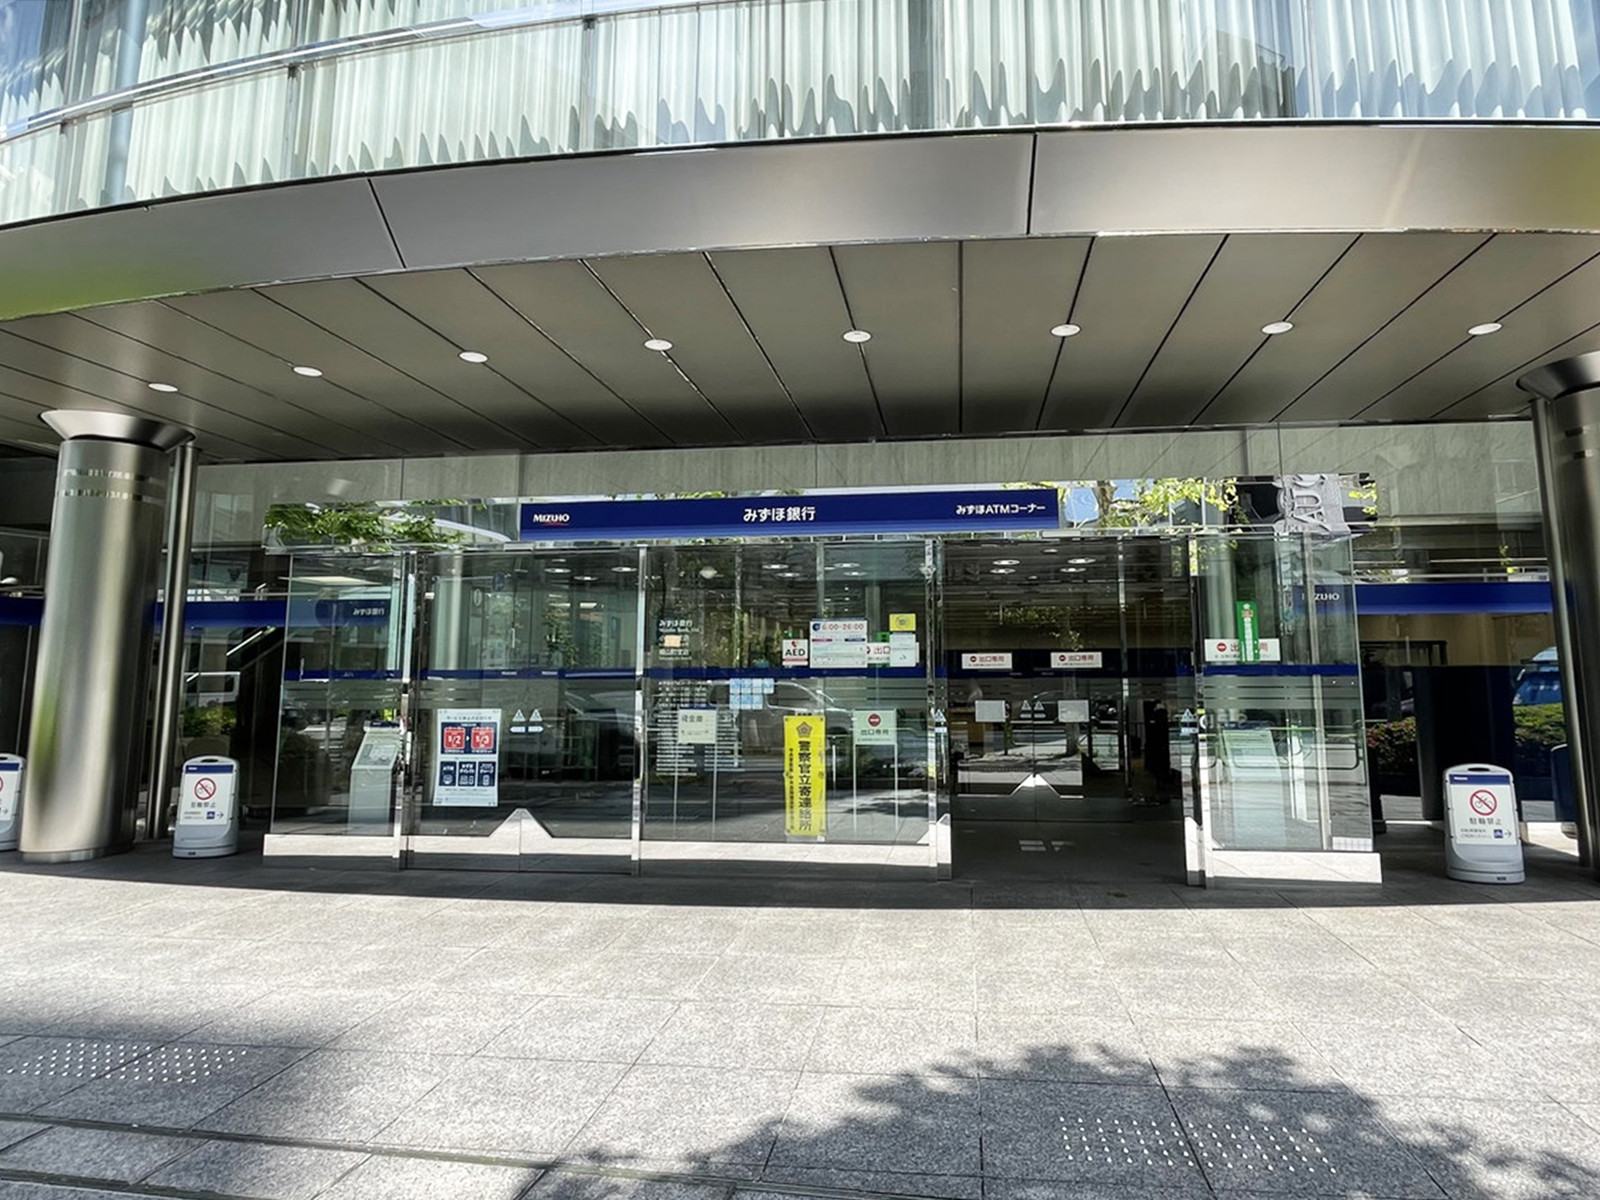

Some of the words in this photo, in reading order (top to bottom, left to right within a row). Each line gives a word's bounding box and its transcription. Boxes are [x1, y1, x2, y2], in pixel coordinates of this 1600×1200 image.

[743, 506, 816, 522] みずほ銀行
[956, 503, 1046, 515] みずほATMコーナー
[533, 513, 570, 523] MIZUHO
[785, 648, 806, 656] AED
